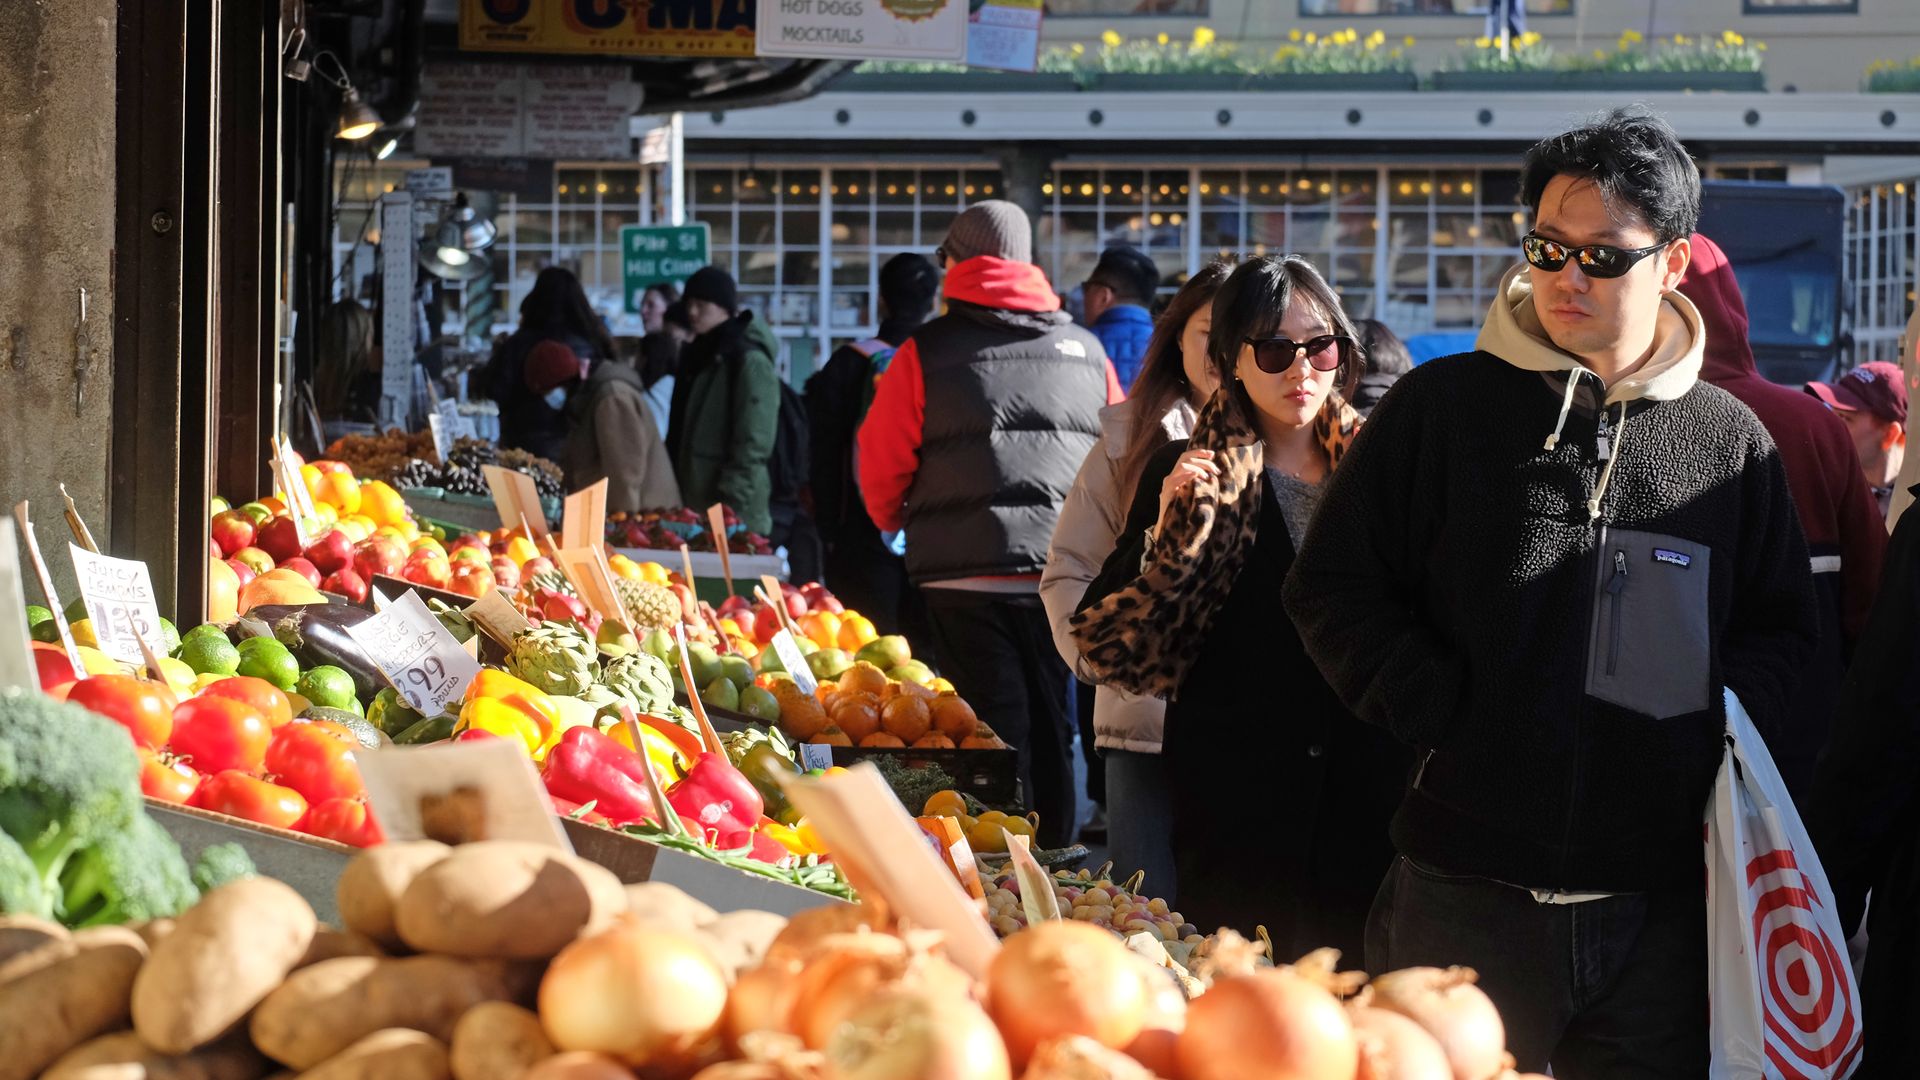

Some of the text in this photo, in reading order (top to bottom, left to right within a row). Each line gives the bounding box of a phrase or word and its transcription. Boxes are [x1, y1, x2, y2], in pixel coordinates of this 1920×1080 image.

[780, 0, 863, 16] HOT DOGS
[782, 25, 864, 43] MOCKTAILS
[632, 233, 697, 252] Pike St
[627, 259, 655, 276] Hill
[1657, 555, 1687, 566] patagonia
[88, 560, 138, 585] JUICY
[88, 576, 146, 599] LEMONS
[431, 676, 460, 708] POUND
